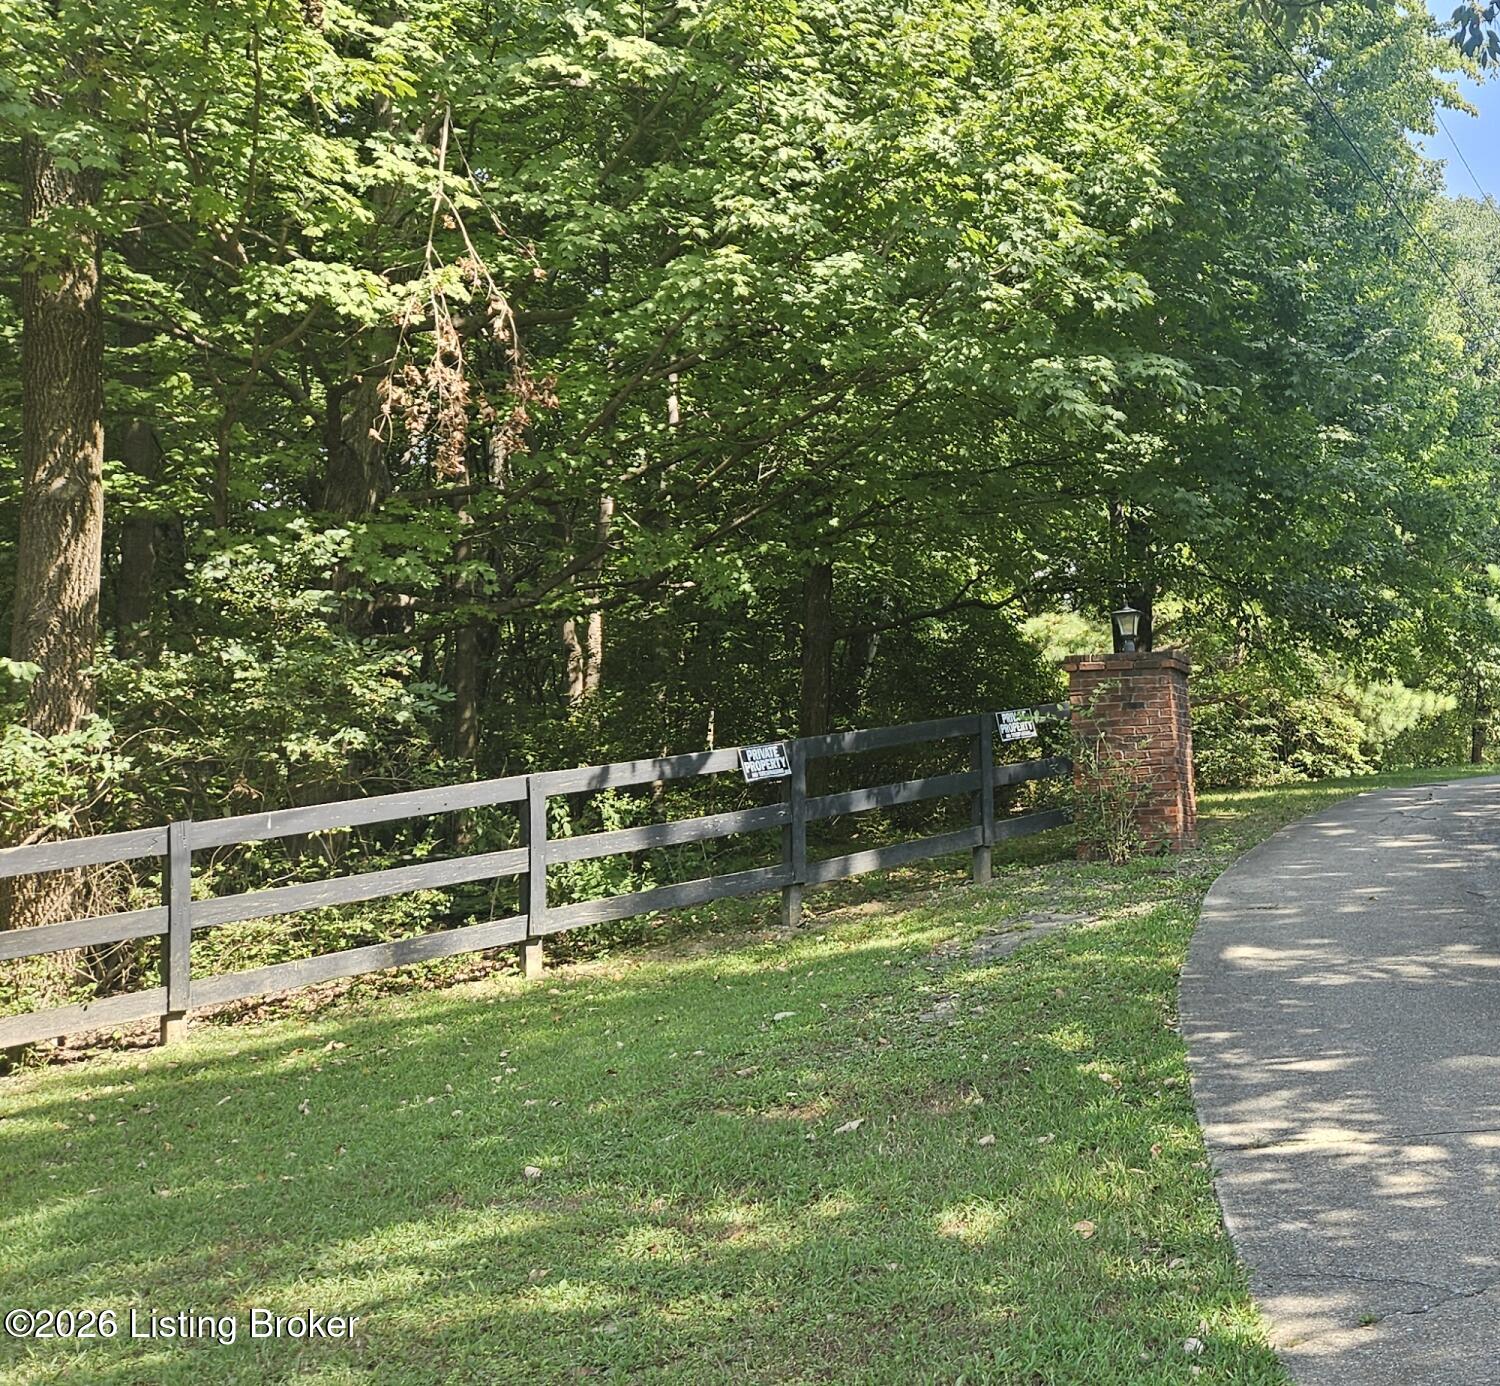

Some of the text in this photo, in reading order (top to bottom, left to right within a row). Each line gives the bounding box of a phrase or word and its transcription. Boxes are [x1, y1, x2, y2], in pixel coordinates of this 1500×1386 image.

[1000, 720, 1033, 734] PROPERTY
[746, 745, 780, 762] PRIVATE
[743, 756, 786, 774] PROPERTY
